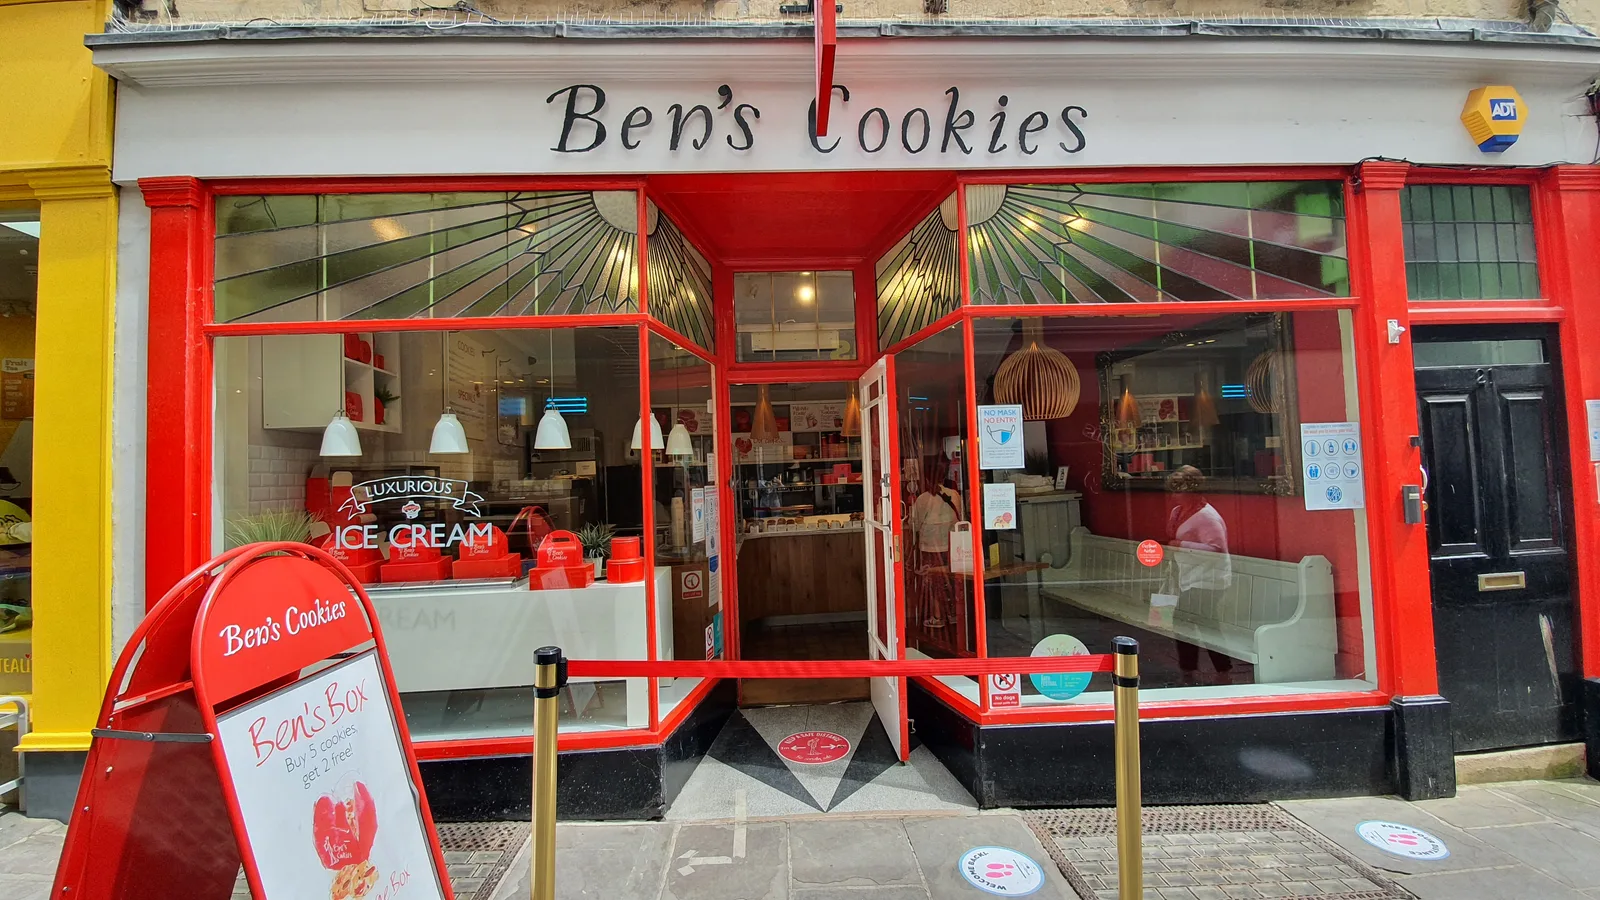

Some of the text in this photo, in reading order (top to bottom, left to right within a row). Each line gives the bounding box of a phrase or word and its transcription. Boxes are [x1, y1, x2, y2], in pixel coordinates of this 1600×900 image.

[546, 84, 1088, 155] Ben's Cookies
[1492, 102, 1516, 117] ADT
[365, 480, 453, 498] LUXURIOUS
[335, 522, 493, 550] ICE CREAM
[219, 598, 346, 657] Ben's Cookies
[248, 702, 326, 767] Ben's
[285, 753, 307, 773] Buy
[309, 744, 318, 759] 5
[302, 742, 354, 789] get 2 free!
[968, 866, 1007, 891] WELCOME
